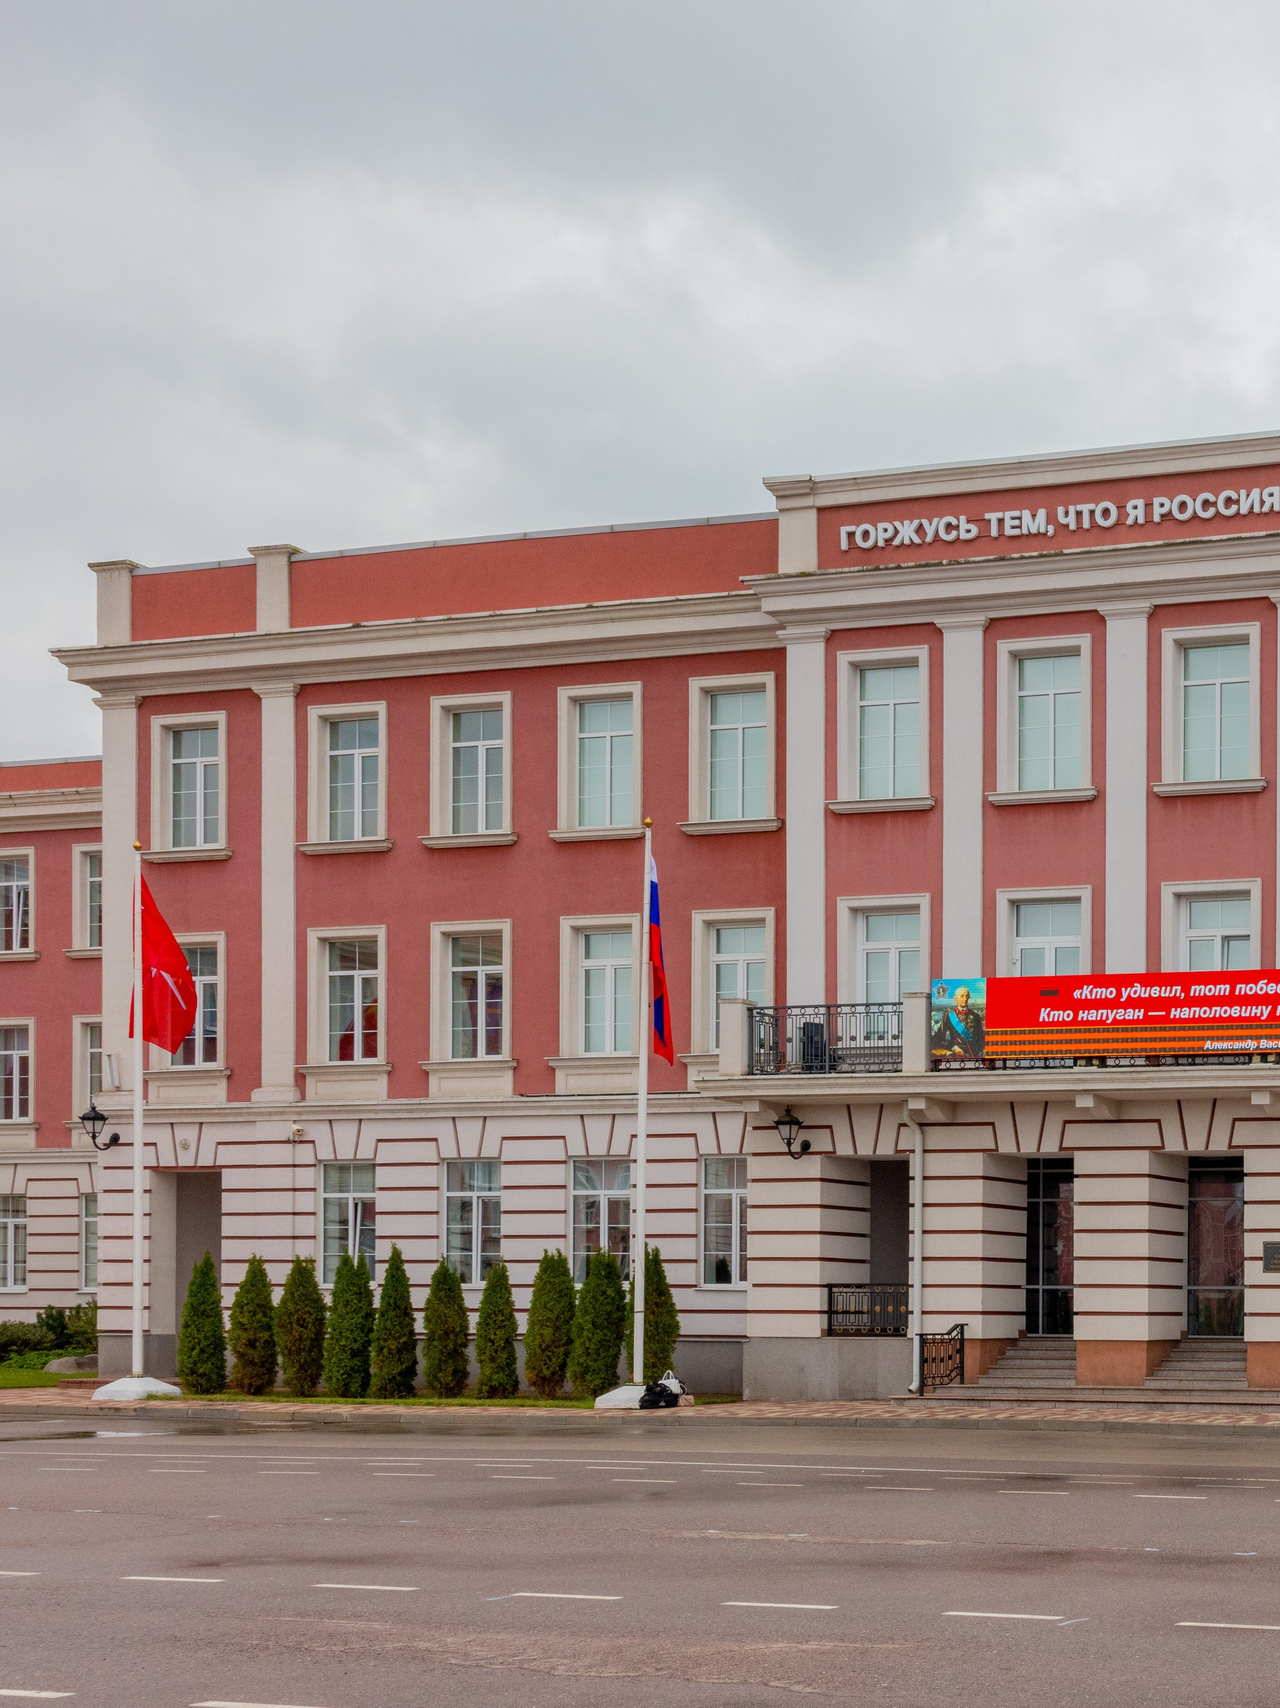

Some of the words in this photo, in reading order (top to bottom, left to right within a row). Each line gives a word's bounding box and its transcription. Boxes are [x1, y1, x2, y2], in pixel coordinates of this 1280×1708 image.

[840, 514, 979, 551] ГОРЖУСЬ
[984, 507, 1055, 538] ТЕМ,
[1057, 500, 1118, 531] ЧТО
[1125, 498, 1145, 526] Я
[1072, 982, 1117, 1000] «Кто
[1119, 984, 1185, 1002] удивил,
[1189, 984, 1231, 997] тот
[1038, 1007, 1074, 1022] Кто
[1077, 1007, 1145, 1023] напуган
[1169, 1004, 1273, 1021] наполовину
[1203, 1038, 1258, 1051] Александр
